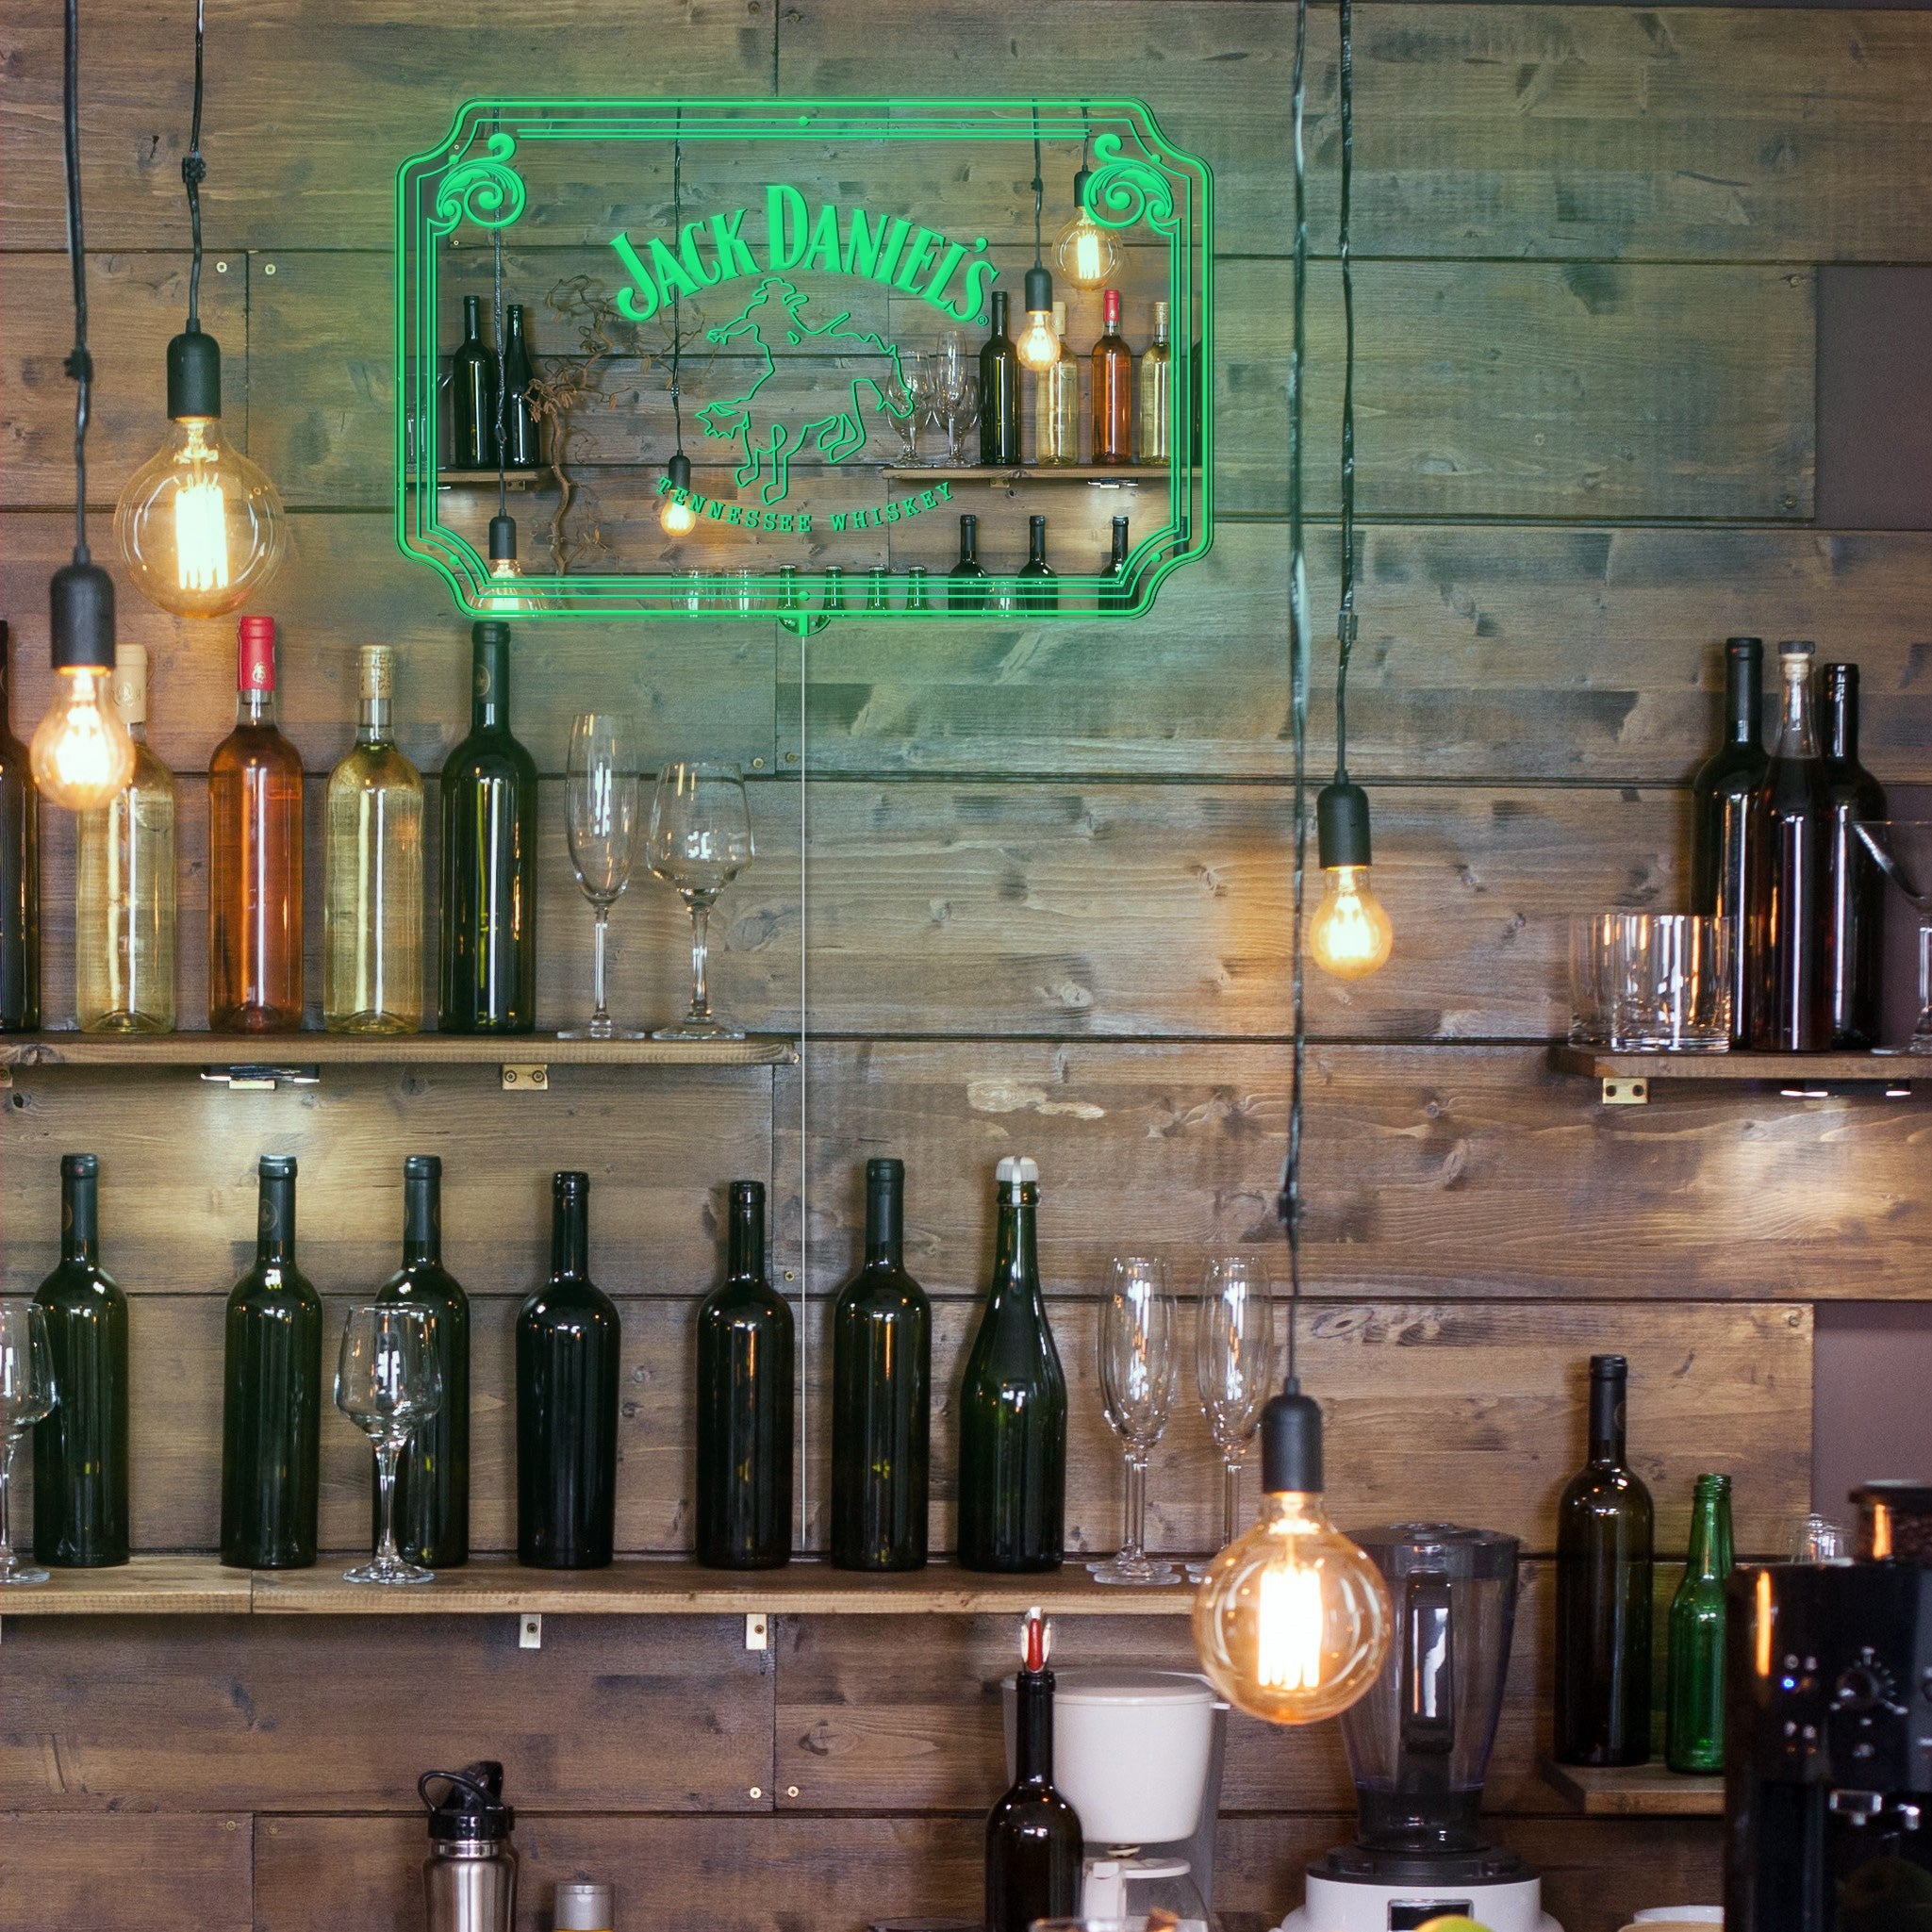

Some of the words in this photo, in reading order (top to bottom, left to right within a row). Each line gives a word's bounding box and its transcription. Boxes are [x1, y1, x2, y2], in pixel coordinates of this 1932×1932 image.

[609, 208, 764, 322] JACK
[766, 185, 1000, 323] DANIEL'S
[655, 476, 813, 533] TENNESSEE
[829, 481, 954, 532] WHISKEY
